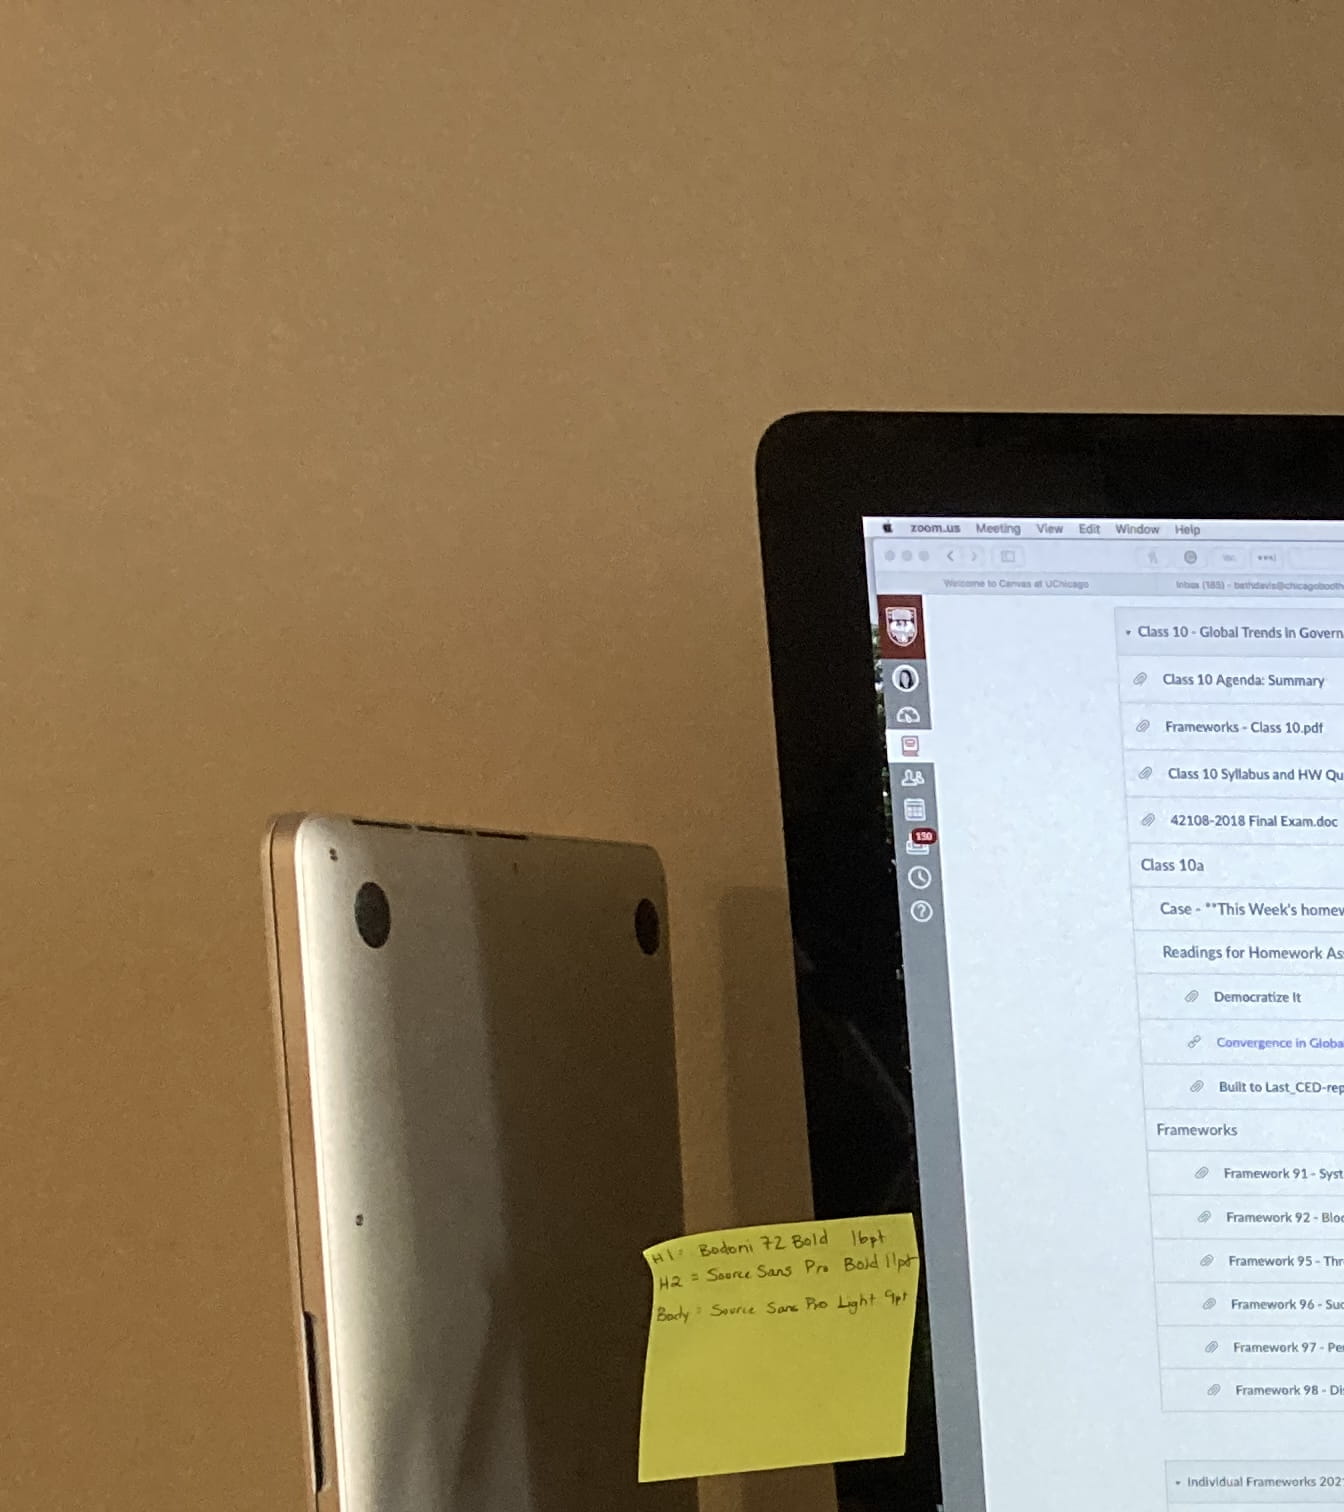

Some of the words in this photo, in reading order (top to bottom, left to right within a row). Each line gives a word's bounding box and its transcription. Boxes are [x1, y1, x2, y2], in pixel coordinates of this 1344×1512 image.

[910, 524, 960, 533] zoom.us
[976, 524, 1021, 536] Meeting
[1036, 524, 1063, 533] View
[1079, 524, 1100, 534] Edit
[1116, 524, 1160, 534] Window
[1175, 524, 1200, 536] Help
[1138, 626, 1169, 637] Class
[1173, 626, 1188, 637] 10
[1200, 626, 1238, 638] Global
[1242, 627, 1282, 638] Trends
[1285, 627, 1296, 638] in
[1163, 674, 1194, 685] Class
[1198, 674, 1212, 685] 10
[1216, 674, 1264, 688] Agenda:
[1268, 675, 1324, 688] Summary
[1166, 721, 1239, 732] Frameworks
[1251, 722, 1281, 733] Class
[1286, 722, 1323, 735] 10.pdf
[1168, 768, 1198, 779] Class
[1203, 768, 1218, 779] 10
[1222, 768, 1270, 782] Syllabus
[1273, 769, 1294, 780] and
[1298, 769, 1322, 780] HW
[1171, 815, 1245, 826] 42108-2018
[1249, 816, 1277, 826] Final
[1281, 816, 1338, 827] Exam.doc
[1141, 858, 1175, 871] Class
[1180, 859, 1204, 871] 10a
[1160, 902, 1192, 915] Case
[1248, 903, 1297, 916] Week's
[1163, 946, 1222, 960] Readings
[1226, 946, 1245, 958] for
[1249, 946, 1322, 959] Homework
[1214, 992, 1289, 1002] Democratize
[1293, 992, 1301, 1002] It
[1217, 1037, 1292, 1050] Convergence
[1296, 1038, 1306, 1048] in
[1157, 1123, 1238, 1136] Frameworks
[1224, 1168, 1290, 1178] Framework
[1293, 1168, 1308, 1179] 91
[759, 1235, 787, 1250] 72
[791, 1229, 829, 1249] Bold
[756, 1263, 793, 1278] Sans
[843, 1251, 879, 1271] Bold
[836, 1294, 878, 1316] Light
[1236, 1385, 1300, 1395] Framework
[1304, 1385, 1318, 1395] 98
[1188, 1476, 1242, 1487] Individual
[1246, 1476, 1316, 1486] Frameworks
